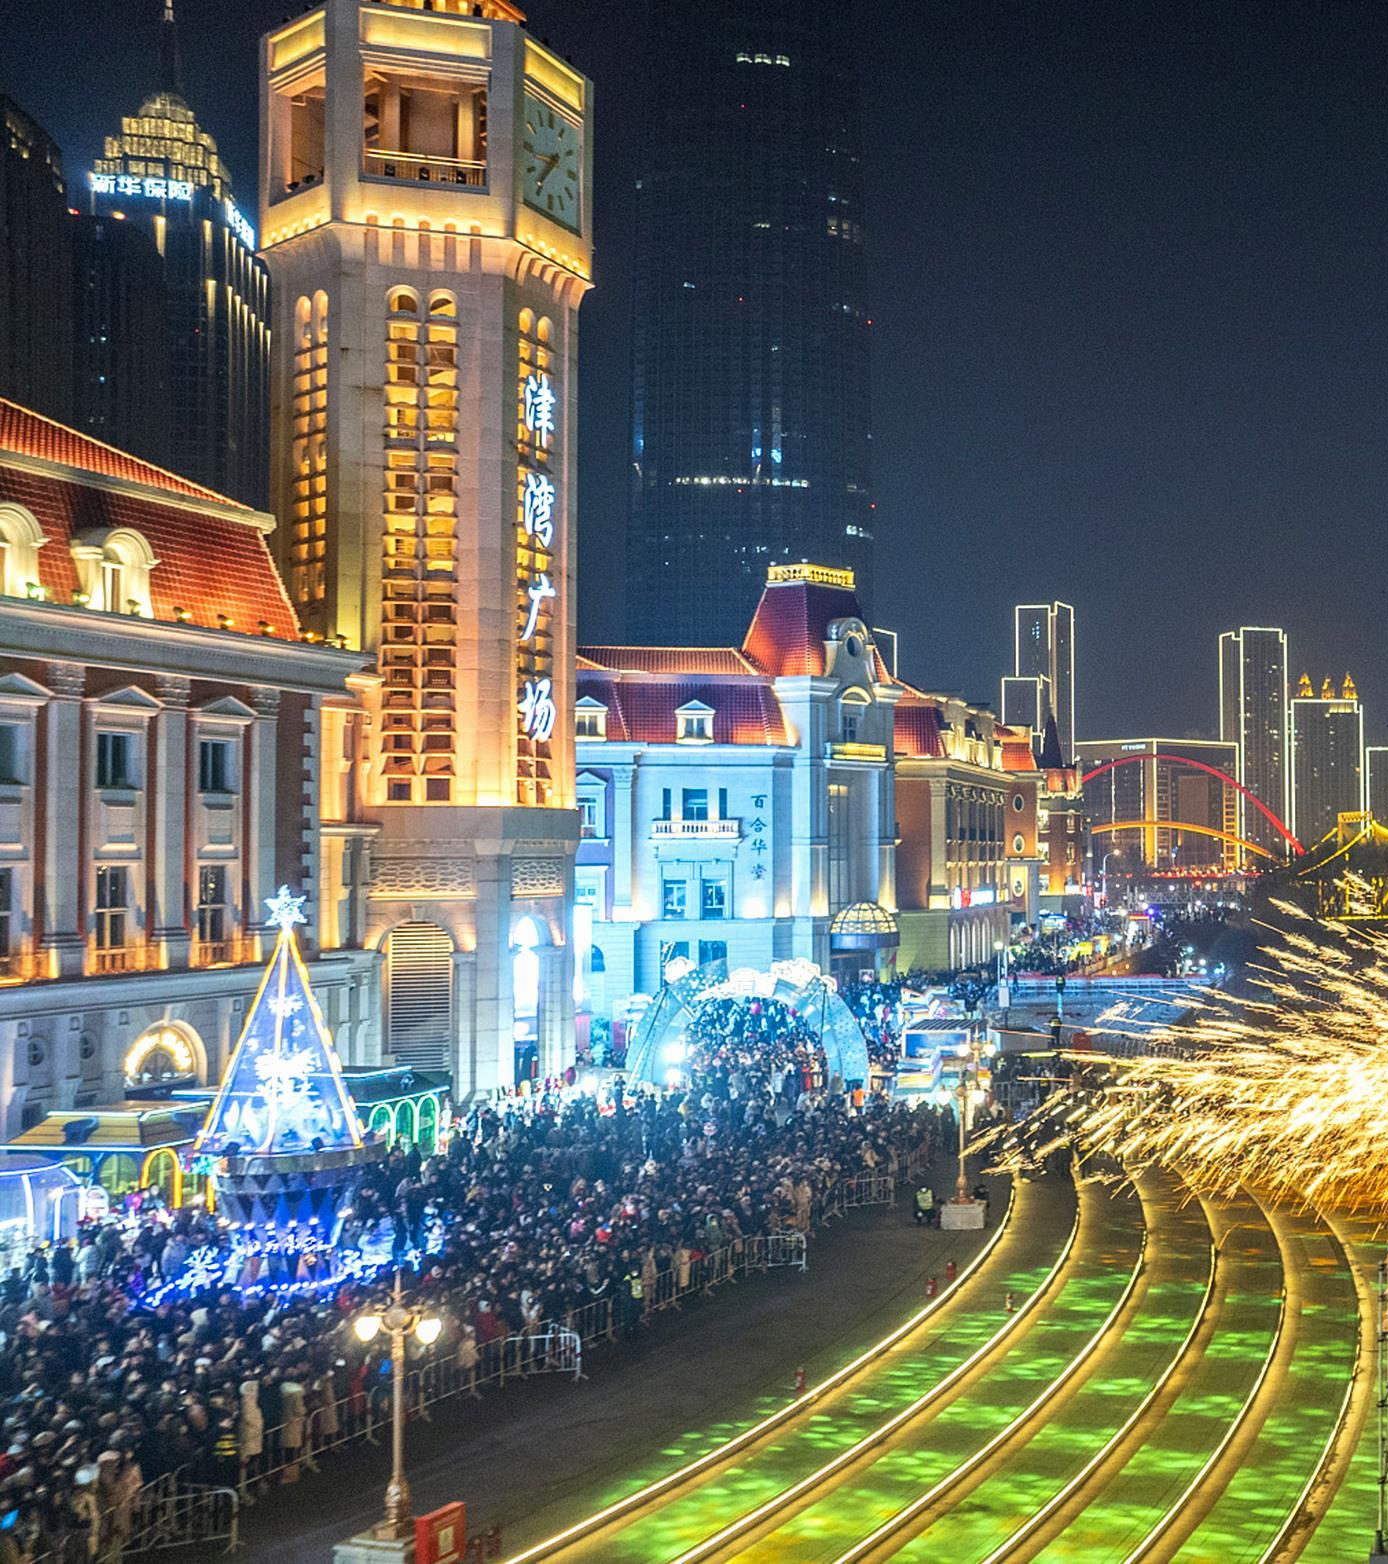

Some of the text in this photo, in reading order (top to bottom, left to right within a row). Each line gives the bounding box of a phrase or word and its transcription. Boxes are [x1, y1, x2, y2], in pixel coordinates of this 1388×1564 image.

[90, 173, 194, 201] 新华保险
[521, 374, 556, 742] 津湾广场
[750, 794, 768, 880] 百合华堂
